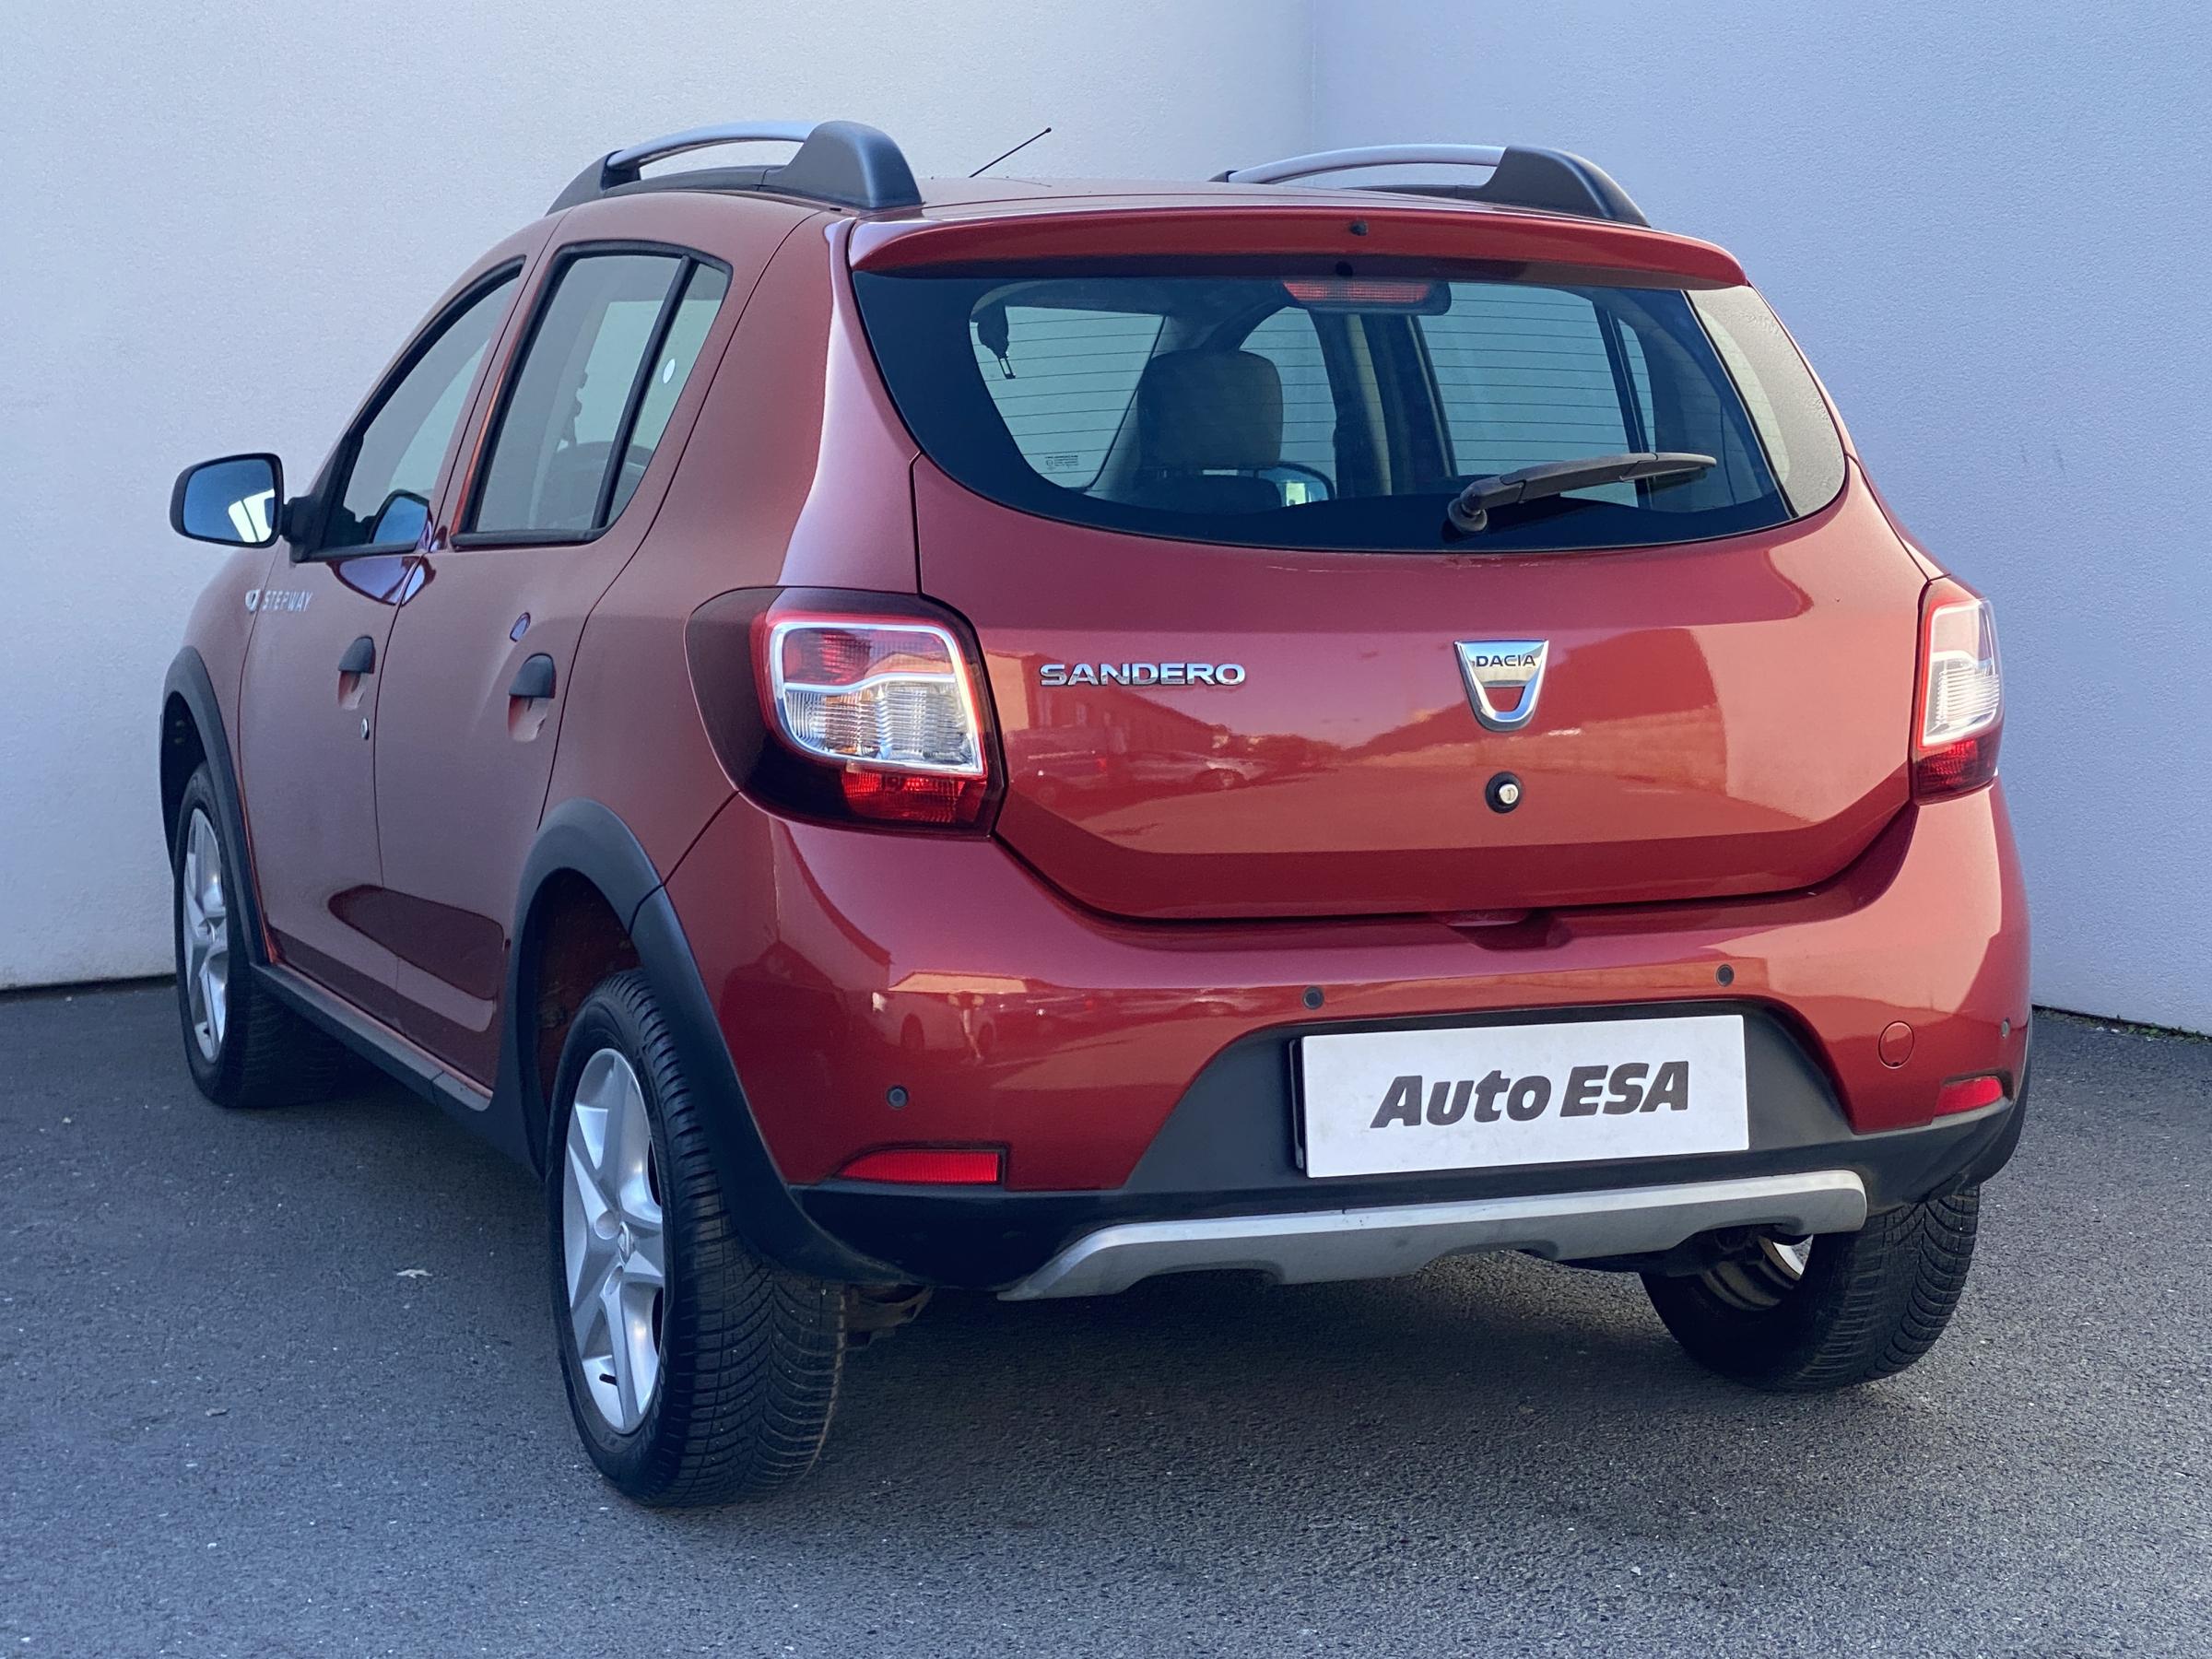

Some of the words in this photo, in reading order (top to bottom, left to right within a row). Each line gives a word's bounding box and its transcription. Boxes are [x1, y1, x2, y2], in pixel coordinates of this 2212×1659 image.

[263, 590, 313, 611] STEPWAY
[1476, 654, 1536, 667] DACIA
[1040, 663, 1246, 686] SANDERO
[1370, 1070, 1552, 1128] Auto
[1559, 1061, 1688, 1117] ESA
